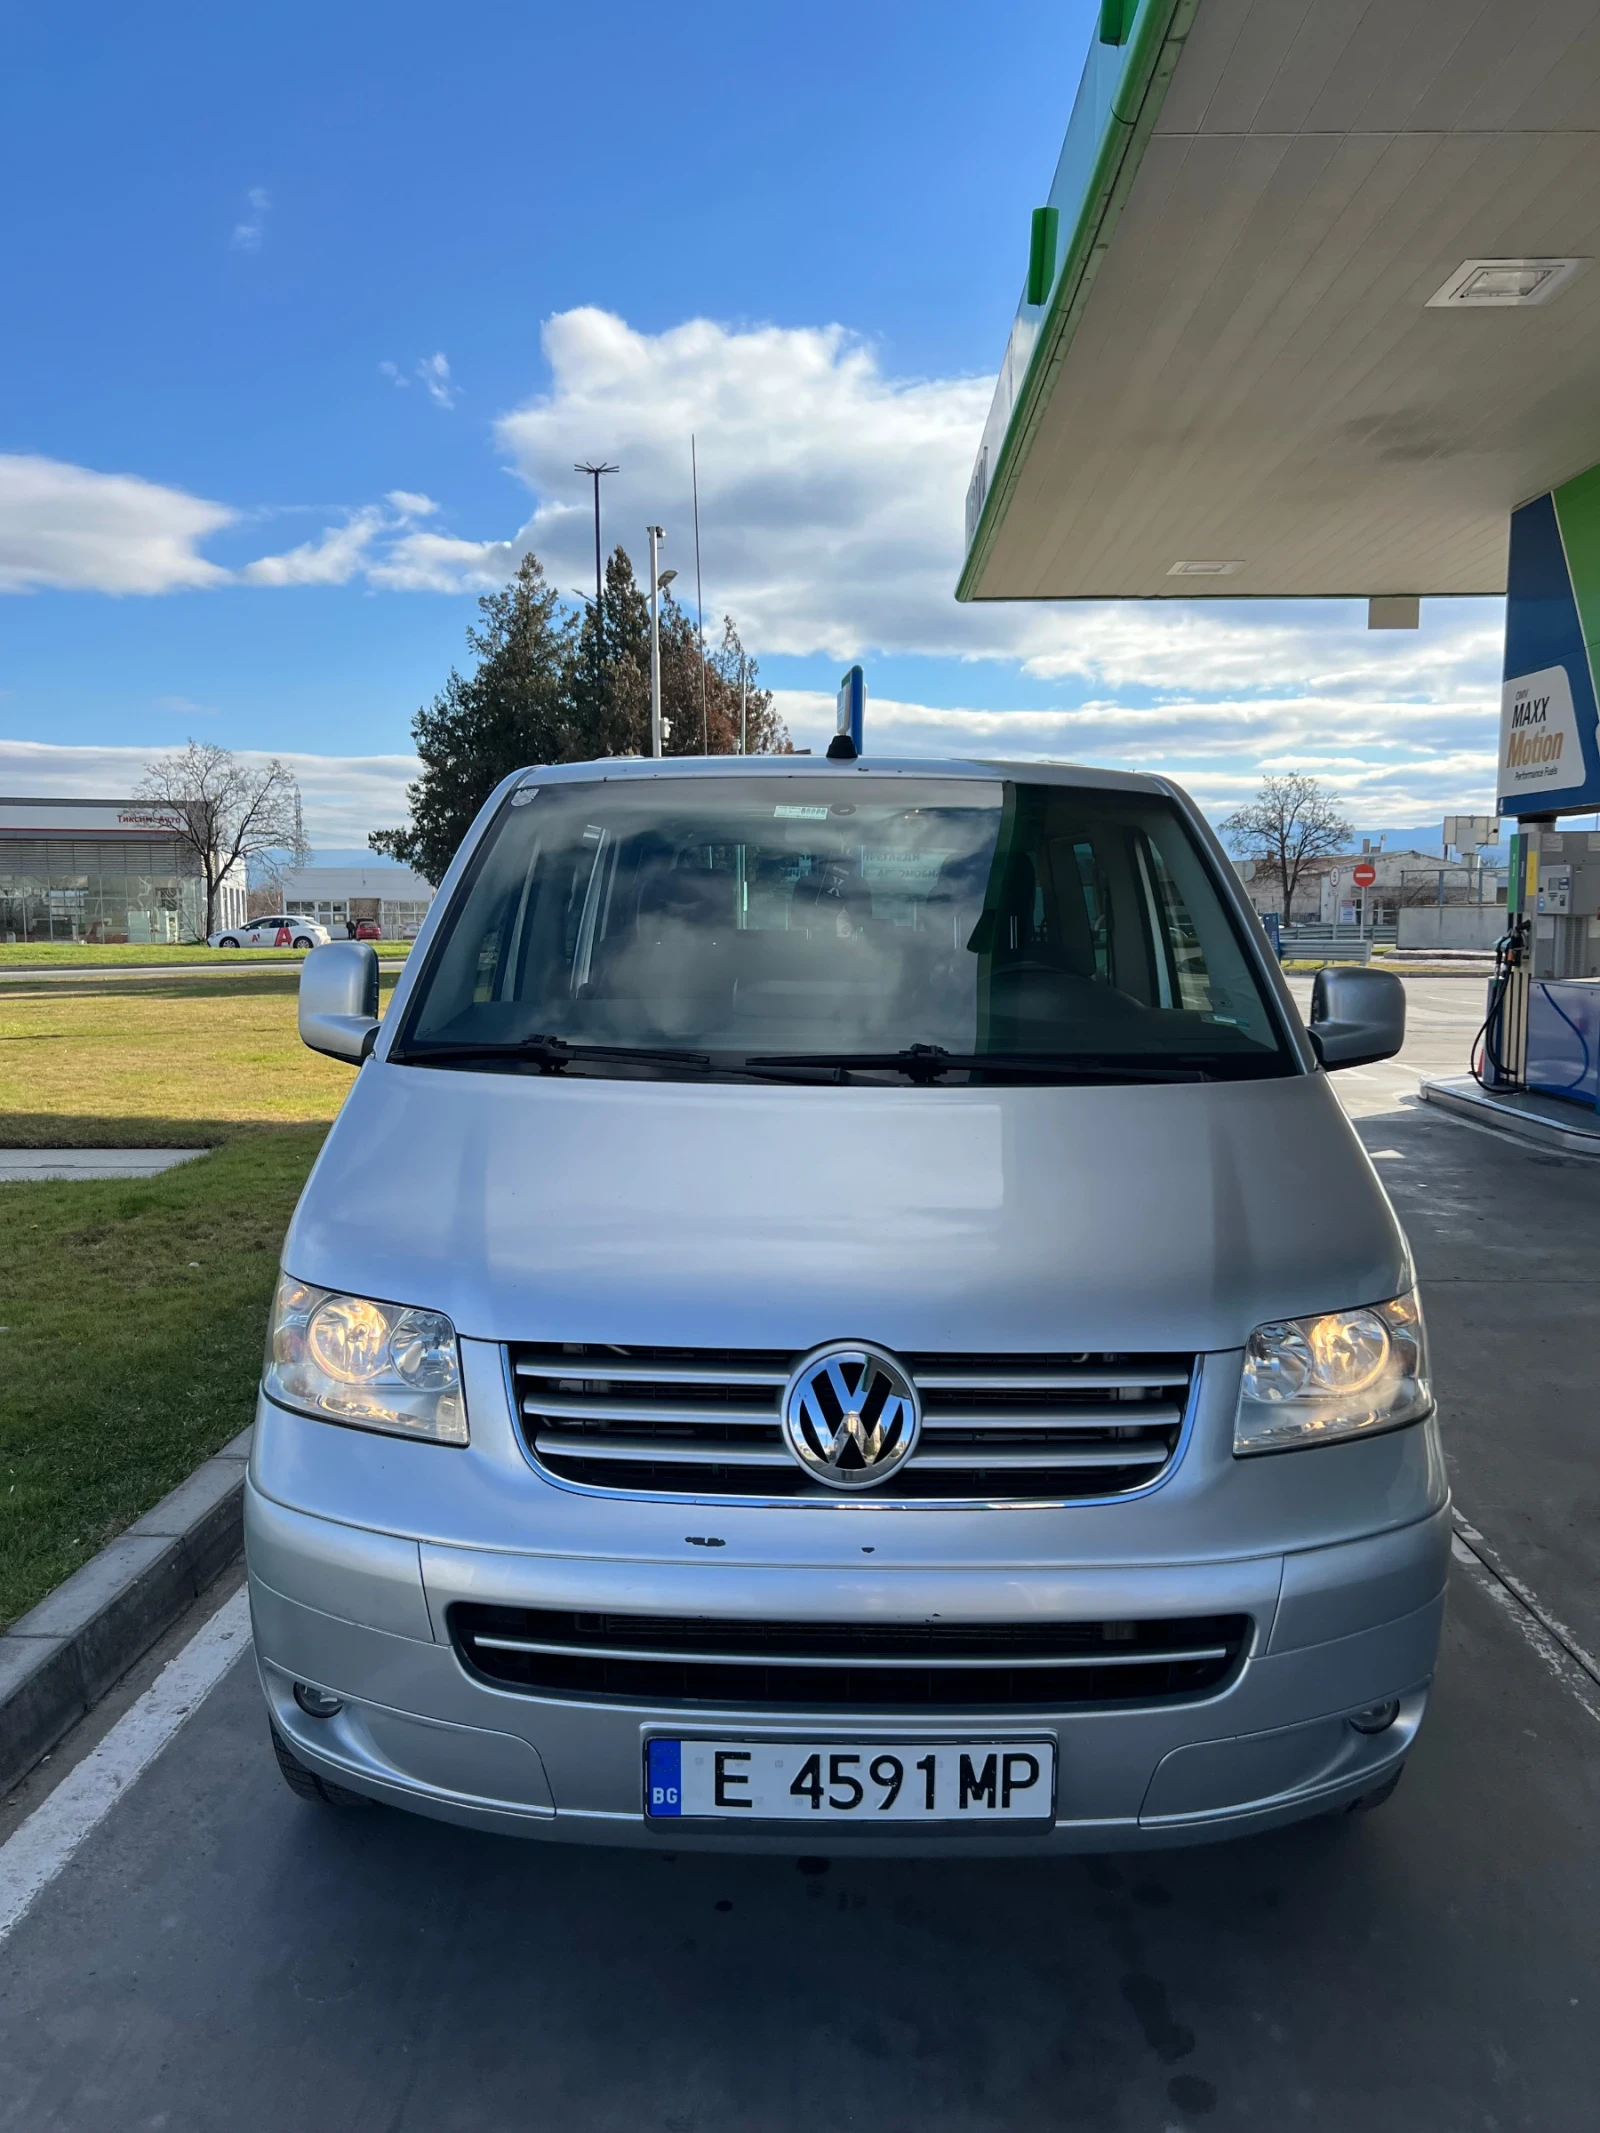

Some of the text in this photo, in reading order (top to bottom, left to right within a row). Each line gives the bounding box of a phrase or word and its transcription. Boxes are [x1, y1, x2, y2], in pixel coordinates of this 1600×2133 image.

[1511, 696, 1550, 729] MAXX
[1506, 726, 1564, 768] Motion
[1514, 766, 1558, 781] Performance Fuels
[788, 1349, 915, 1484] VW
[652, 1788, 678, 1805] BG
[714, 1751, 1040, 1810] E 4591 MP
